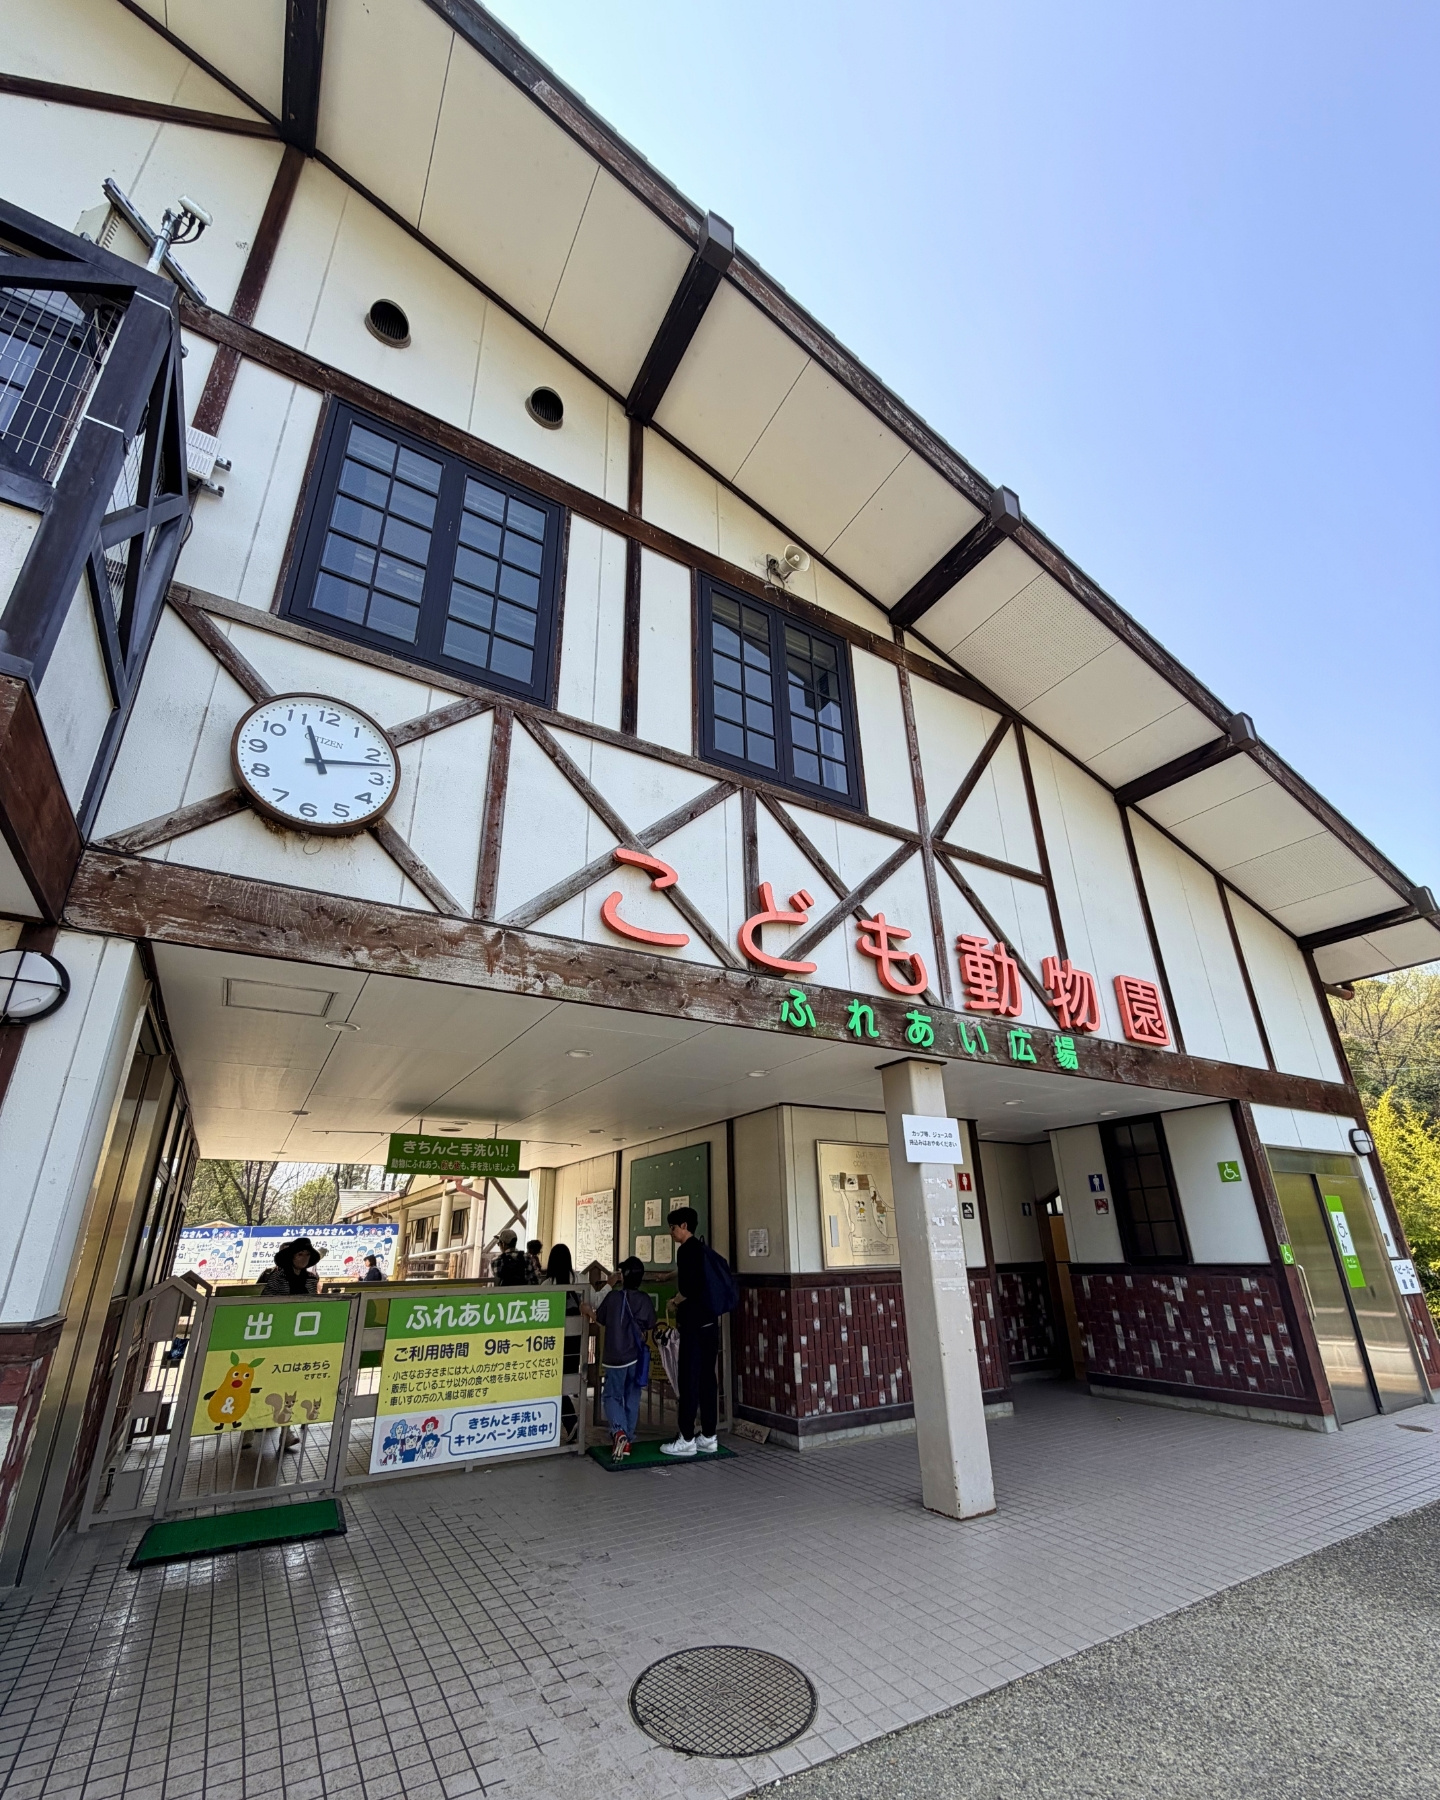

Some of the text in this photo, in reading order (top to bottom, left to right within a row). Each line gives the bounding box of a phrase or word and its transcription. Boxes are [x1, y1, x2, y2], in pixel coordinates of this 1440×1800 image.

[287, 709, 308, 725] 11
[319, 710, 341, 727] 12
[262, 720, 287, 736] 10
[353, 727, 360, 738] 1
[249, 738, 268, 753] 9
[304, 732, 344, 750] CTIZEN
[364, 748, 381, 762] 2
[250, 763, 270, 778] 8
[368, 772, 385, 786] 3
[272, 787, 290, 802] 7
[354, 792, 373, 804] 4
[299, 803, 318, 817] 6
[332, 803, 350, 818] 5
[600, 848, 1170, 1047] こども動物園
[781, 989, 1079, 1070] ふれあい広場
[180, 1229, 210, 1239] なさんへ
[283, 1227, 354, 1237] よい子のみなさんへ
[406, 1299, 550, 1330] ふれあい広場
[244, 1311, 321, 1341] 出口
[394, 1342, 469, 1363] ご利用時間
[271, 1360, 331, 1375] 入口はあちら
[468, 1410, 542, 1430] きちんと手洗い
